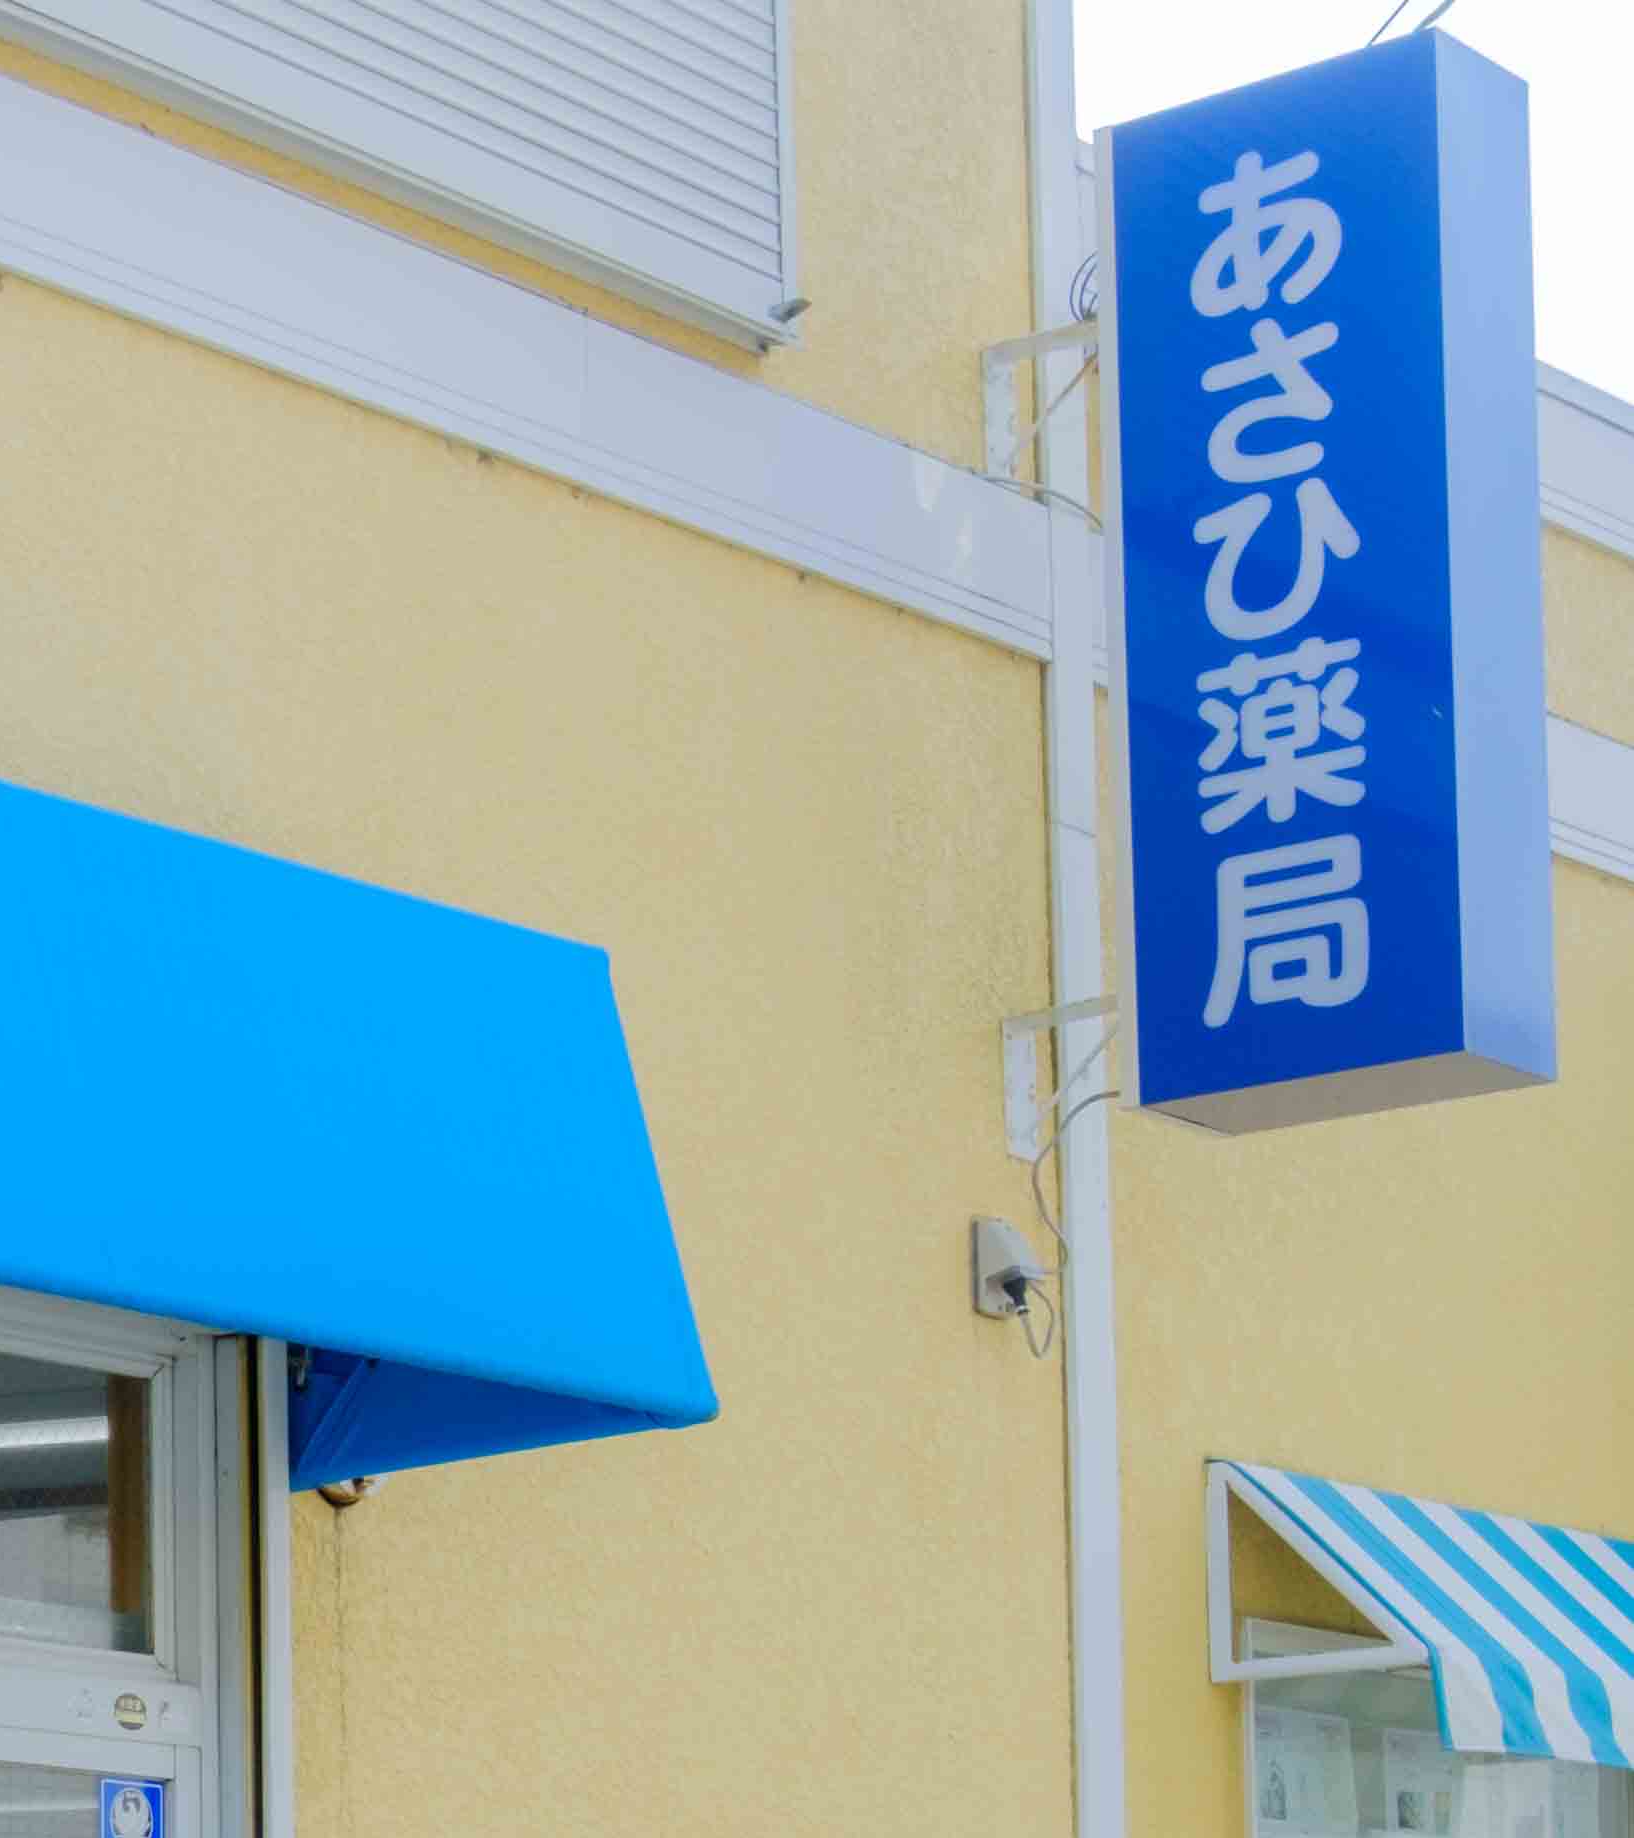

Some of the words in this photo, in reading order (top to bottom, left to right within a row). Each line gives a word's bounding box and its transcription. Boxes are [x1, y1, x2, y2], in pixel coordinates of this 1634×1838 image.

[1190, 151, 1371, 1027] あさひ薬局
